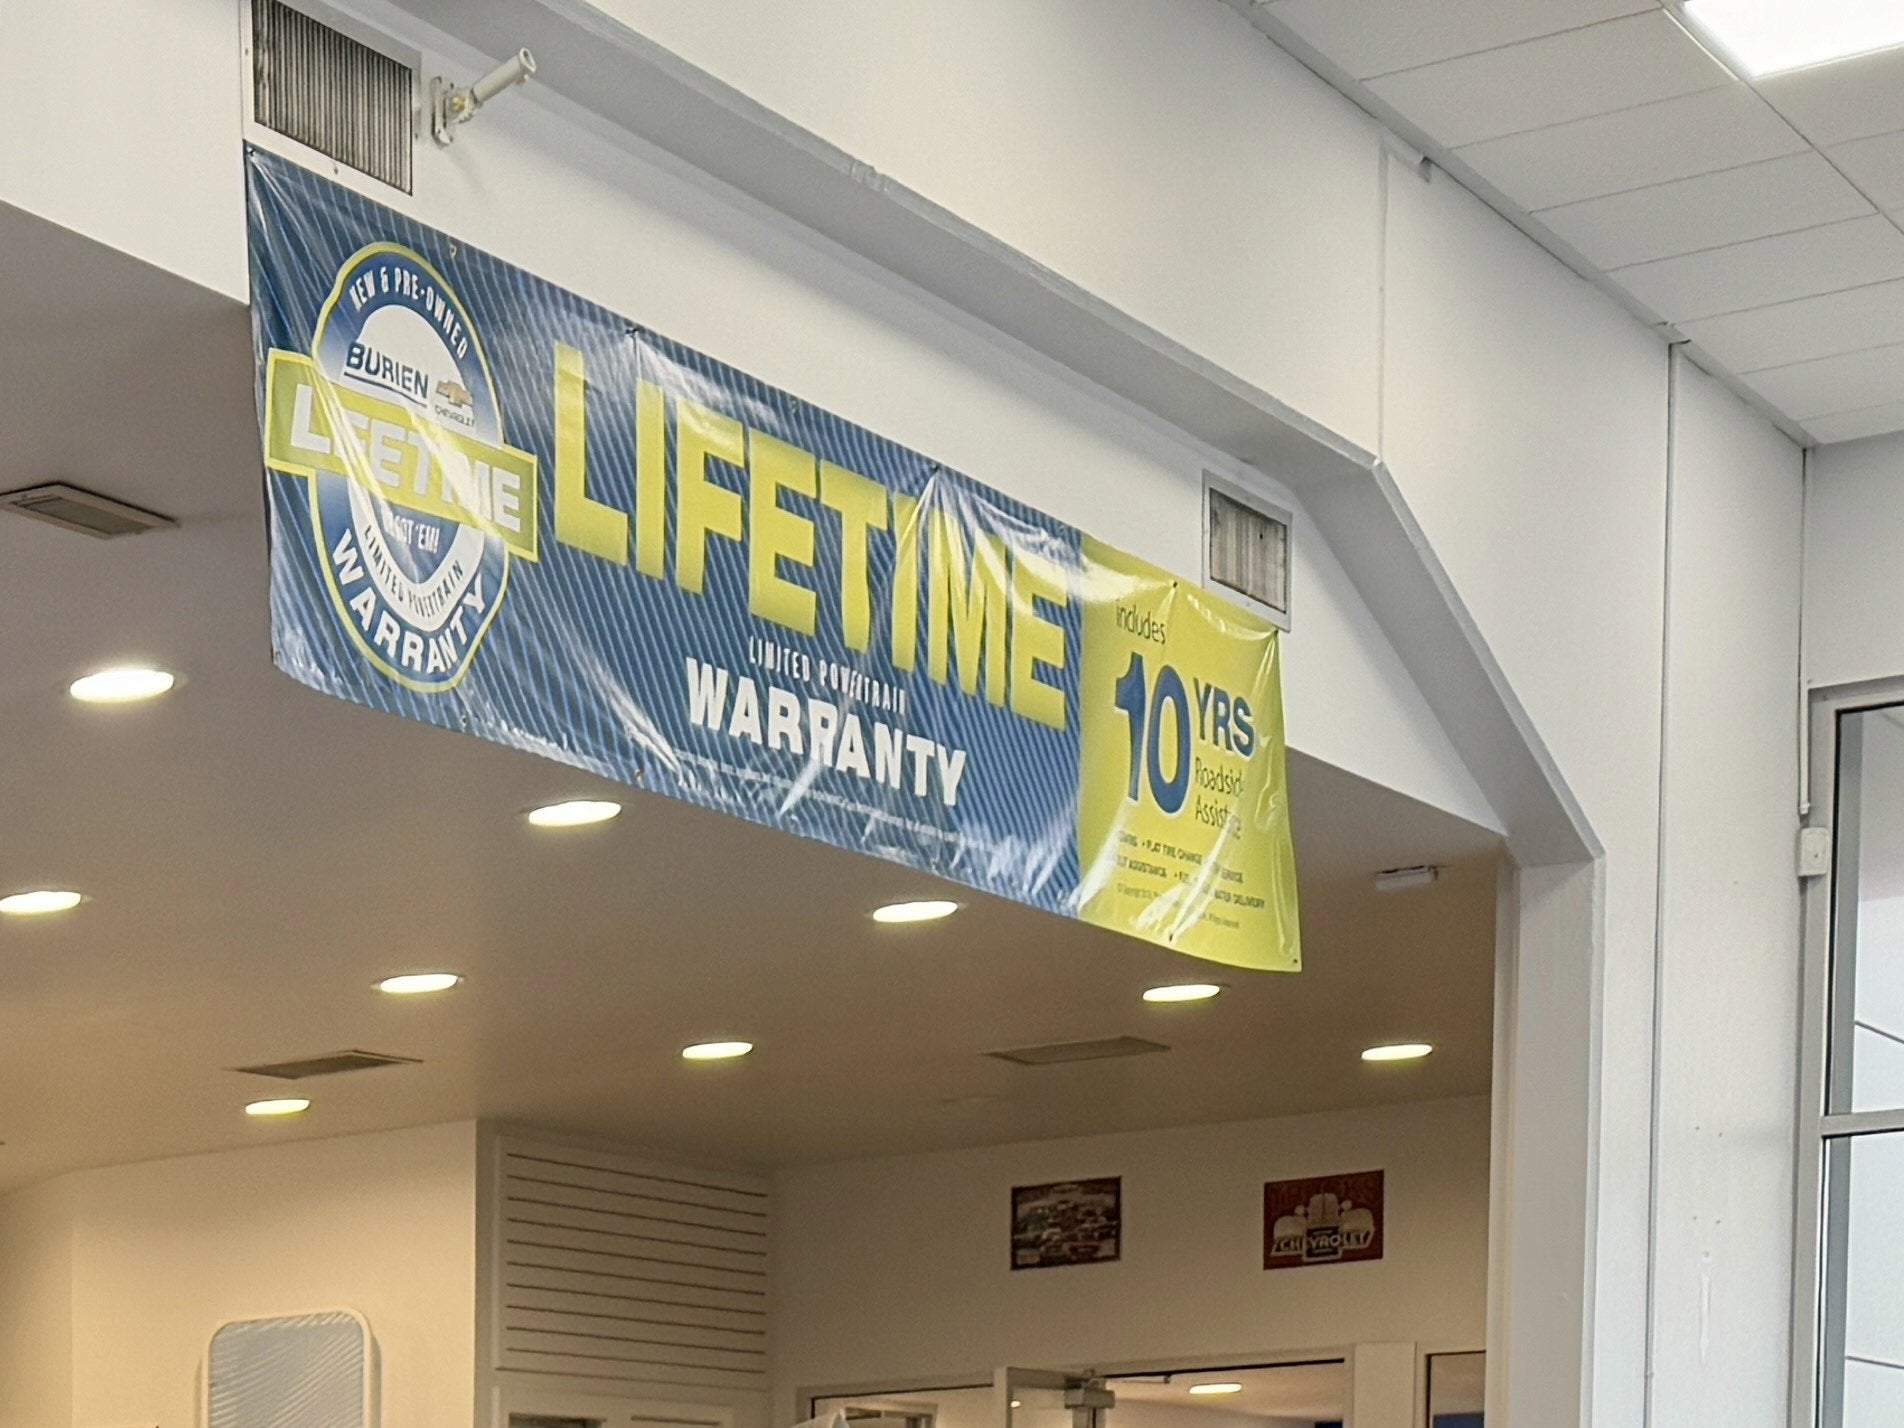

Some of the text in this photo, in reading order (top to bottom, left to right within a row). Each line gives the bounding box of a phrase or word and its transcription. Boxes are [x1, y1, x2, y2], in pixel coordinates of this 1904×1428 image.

[349, 265, 469, 360] NEW & PRE-OWNED
[345, 340, 430, 400] BURIEN
[364, 525, 405, 602] LIMITED
[553, 339, 1069, 733] LIFETIME
[332, 527, 485, 675] WARRANTY
[1115, 602, 1167, 646] includes
[748, 636, 811, 683] LIMITED
[685, 656, 968, 808] WARRANTY
[1113, 651, 1192, 817] 10
[1192, 676, 1256, 760] YRS
[1195, 755, 1244, 800] Roadsid
